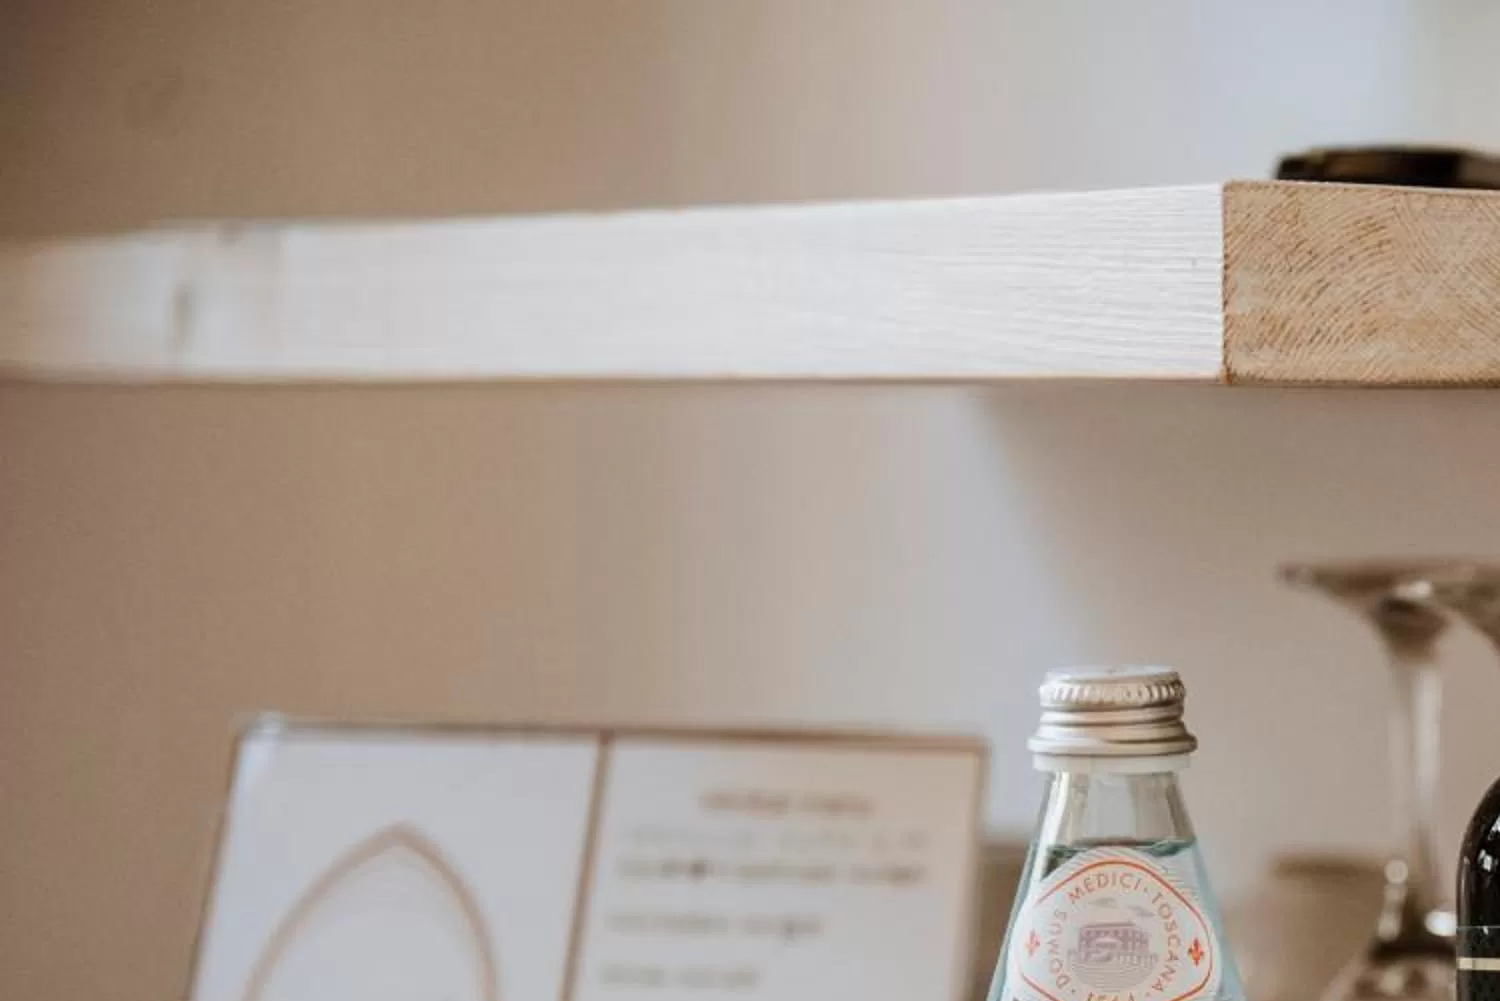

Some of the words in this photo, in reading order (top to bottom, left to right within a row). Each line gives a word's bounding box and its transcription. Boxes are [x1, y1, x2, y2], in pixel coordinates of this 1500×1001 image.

[1048, 908, 1068, 990] DOMUS
[1067, 871, 1142, 904] MEDICI
[1151, 891, 1182, 993] TOSCANA
